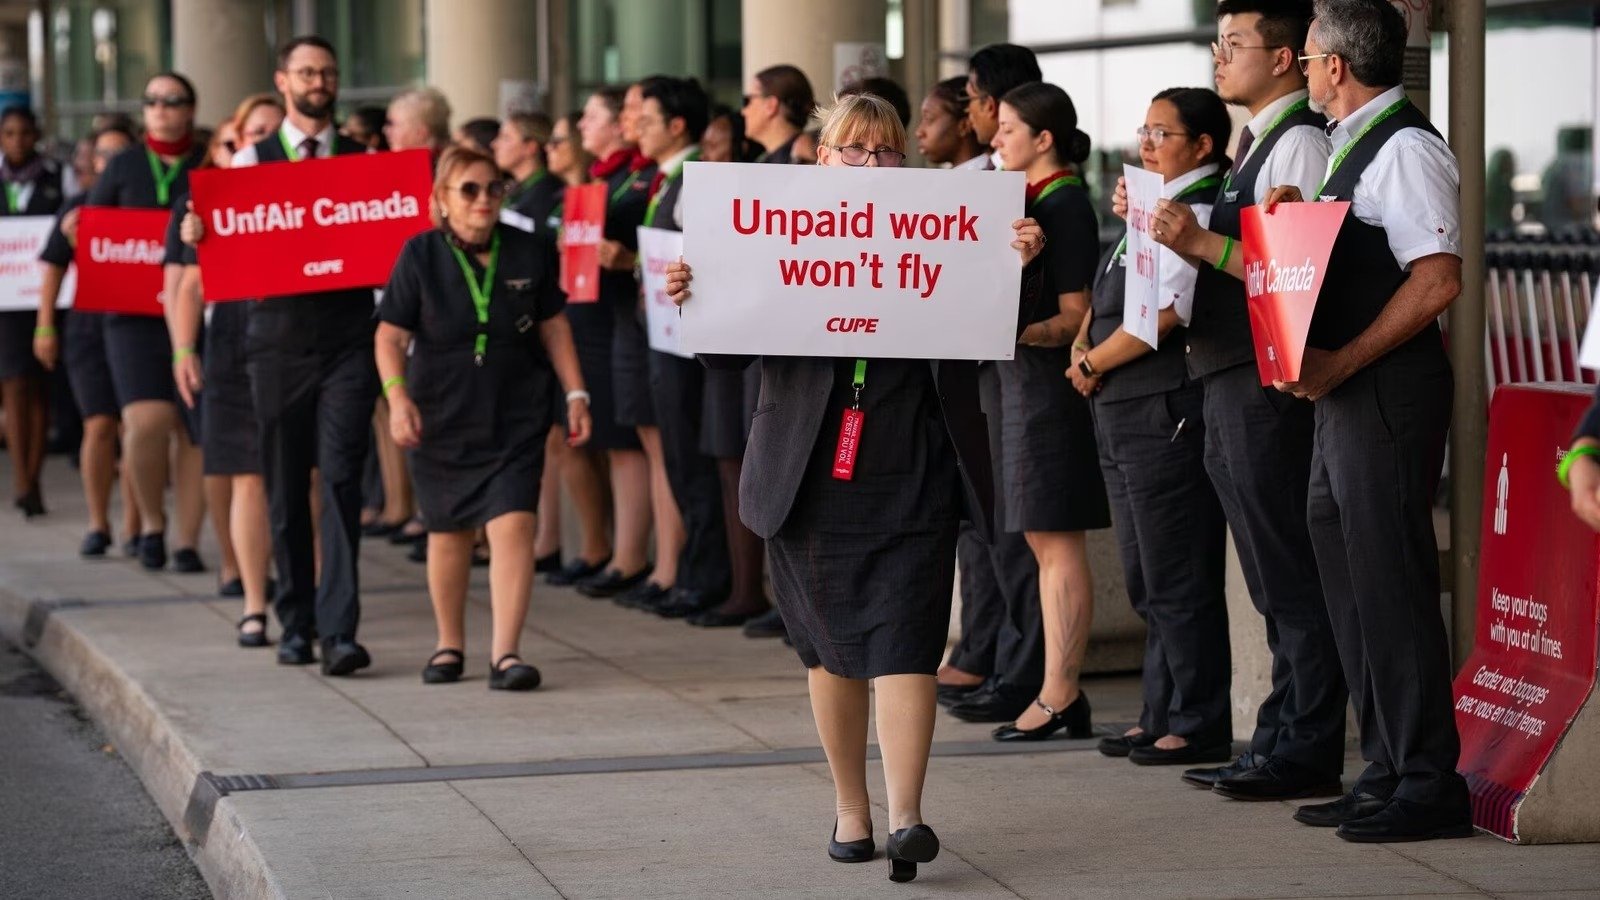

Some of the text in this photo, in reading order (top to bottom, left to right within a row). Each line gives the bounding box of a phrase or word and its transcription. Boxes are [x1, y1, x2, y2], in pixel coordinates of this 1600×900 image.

[212, 190, 420, 236] UnfAir Canada
[733, 198, 980, 245] Unpaid work
[303, 258, 344, 277] CUPE
[779, 252, 942, 298] won't fly
[1267, 257, 1316, 294] Canada
[826, 317, 879, 333] CUPE
[838, 449, 847, 463] VOL
[842, 437, 850, 448] DU
[1492, 587, 1547, 627] Keep your bags
[1490, 617, 1562, 659] with you at all times.
[1473, 665, 1549, 707] Gardez vos bagages
[1455, 695, 1478, 713] avec
[1473, 700, 1495, 719] vous
[1490, 706, 1505, 722] en
[1500, 706, 1524, 728] tout
